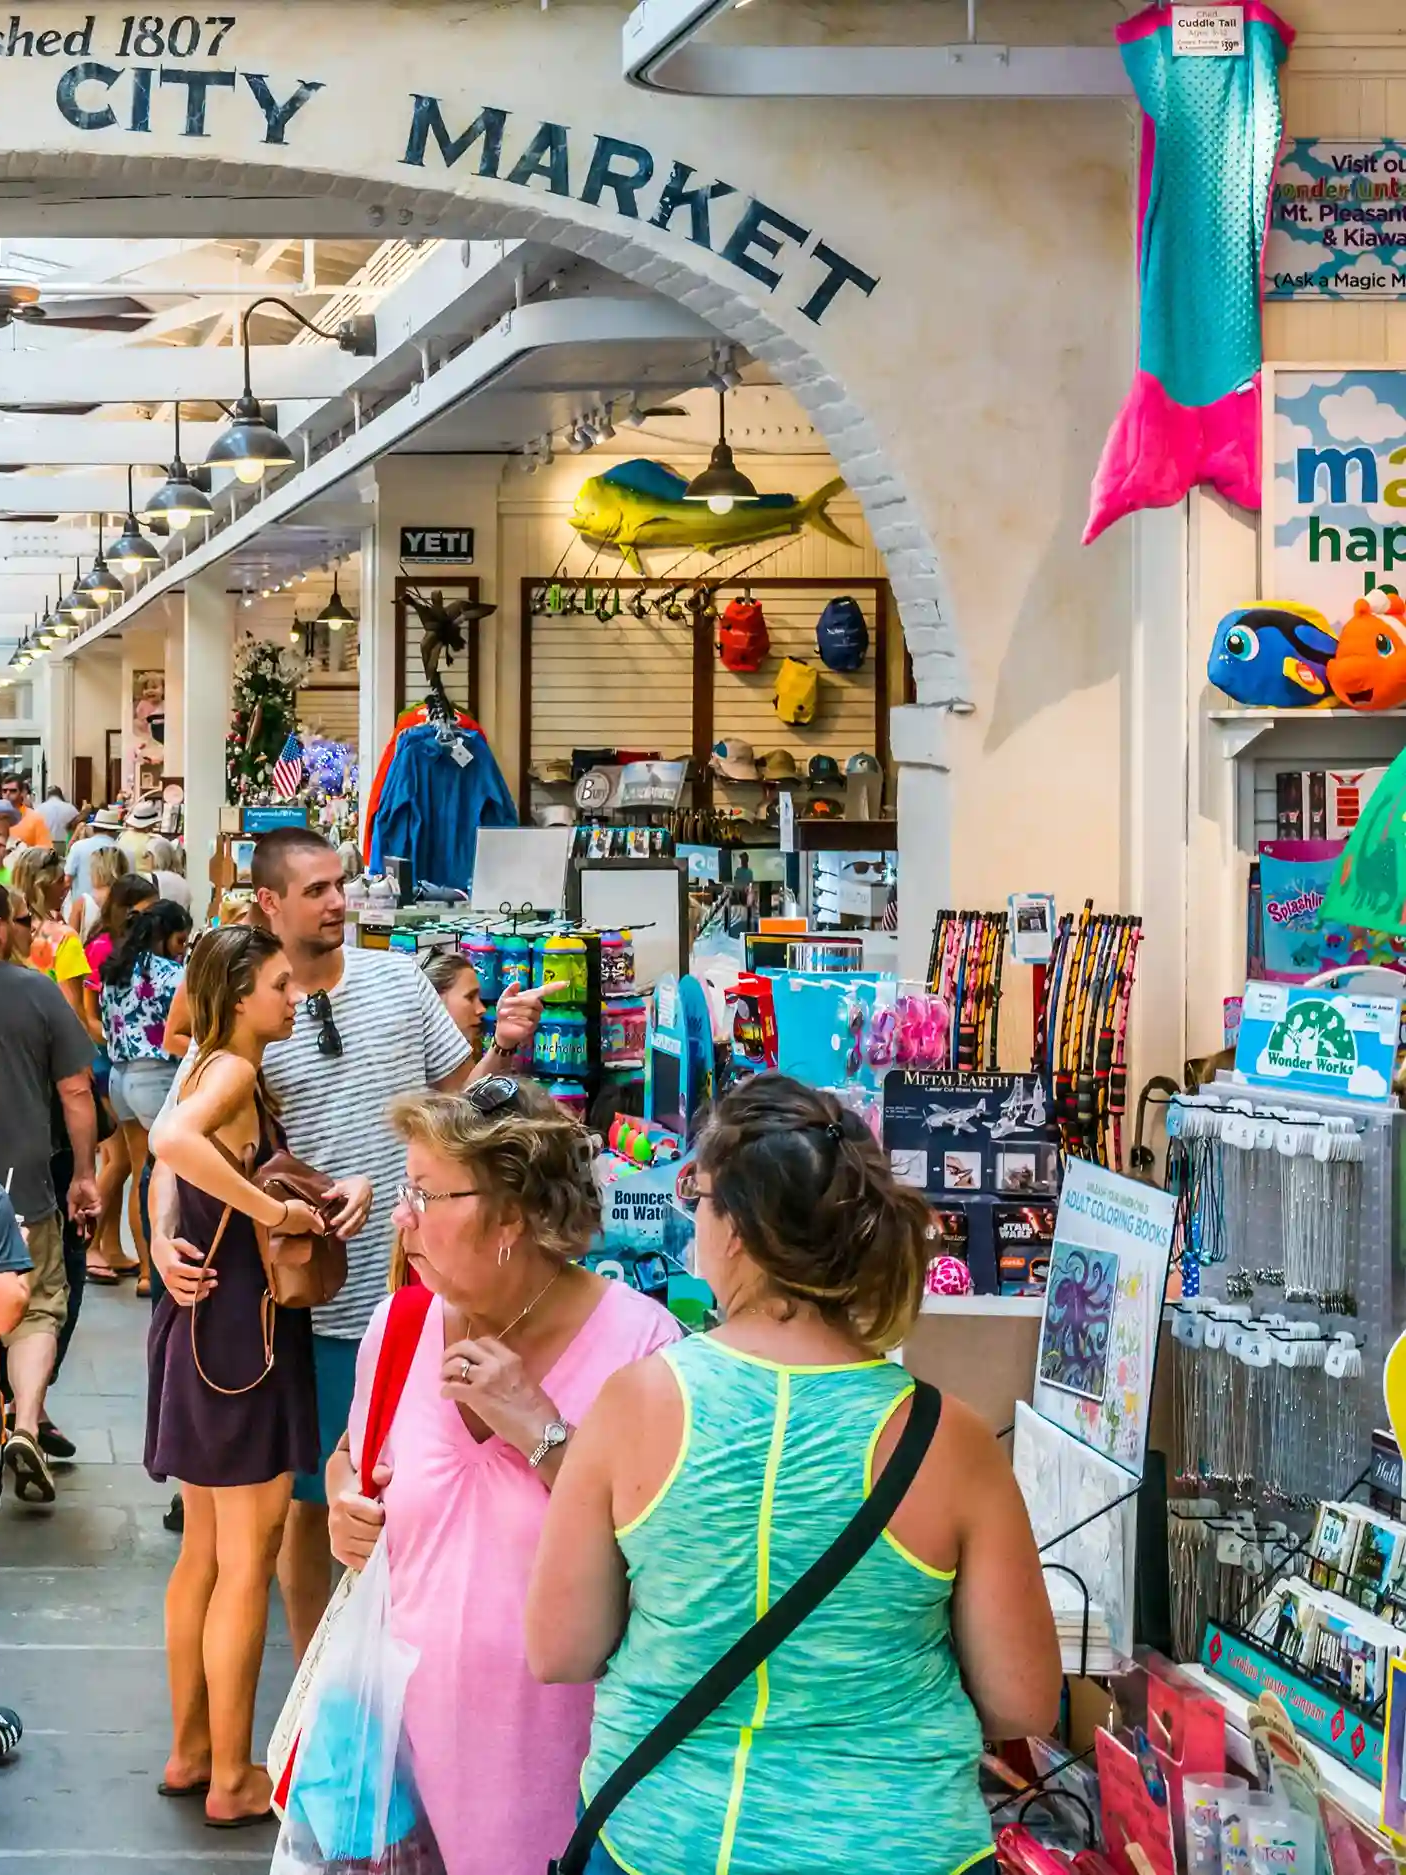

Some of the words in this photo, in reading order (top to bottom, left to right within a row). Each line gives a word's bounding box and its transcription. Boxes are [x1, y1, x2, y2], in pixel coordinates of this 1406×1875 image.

[1178, 19, 1215, 28] Cuddle
[115, 15, 236, 58] 1807
[1332, 154, 1377, 174] Visit
[55, 61, 327, 146] CITY
[396, 92, 882, 327] MARKET
[1281, 204, 1313, 222] Mt.
[1322, 228, 1338, 247] &
[1274, 272, 1314, 289] (Ask
[1319, 277, 1329, 287] a
[1334, 272, 1386, 290] Magic
[405, 532, 470, 553] YETI
[1268, 1051, 1313, 1070] Wonder
[1316, 1058, 1354, 1075] Works
[903, 1070, 956, 1086] METAL
[957, 1071, 1011, 1088] EARTH
[614, 1190, 673, 1205] Bounces
[612, 1207, 629, 1220] on
[1063, 1190, 1091, 1213] ADULT
[1090, 1200, 1135, 1234] COLORING
[1134, 1218, 1169, 1247] BOOKS
[1003, 1223, 1031, 1232] STAR
